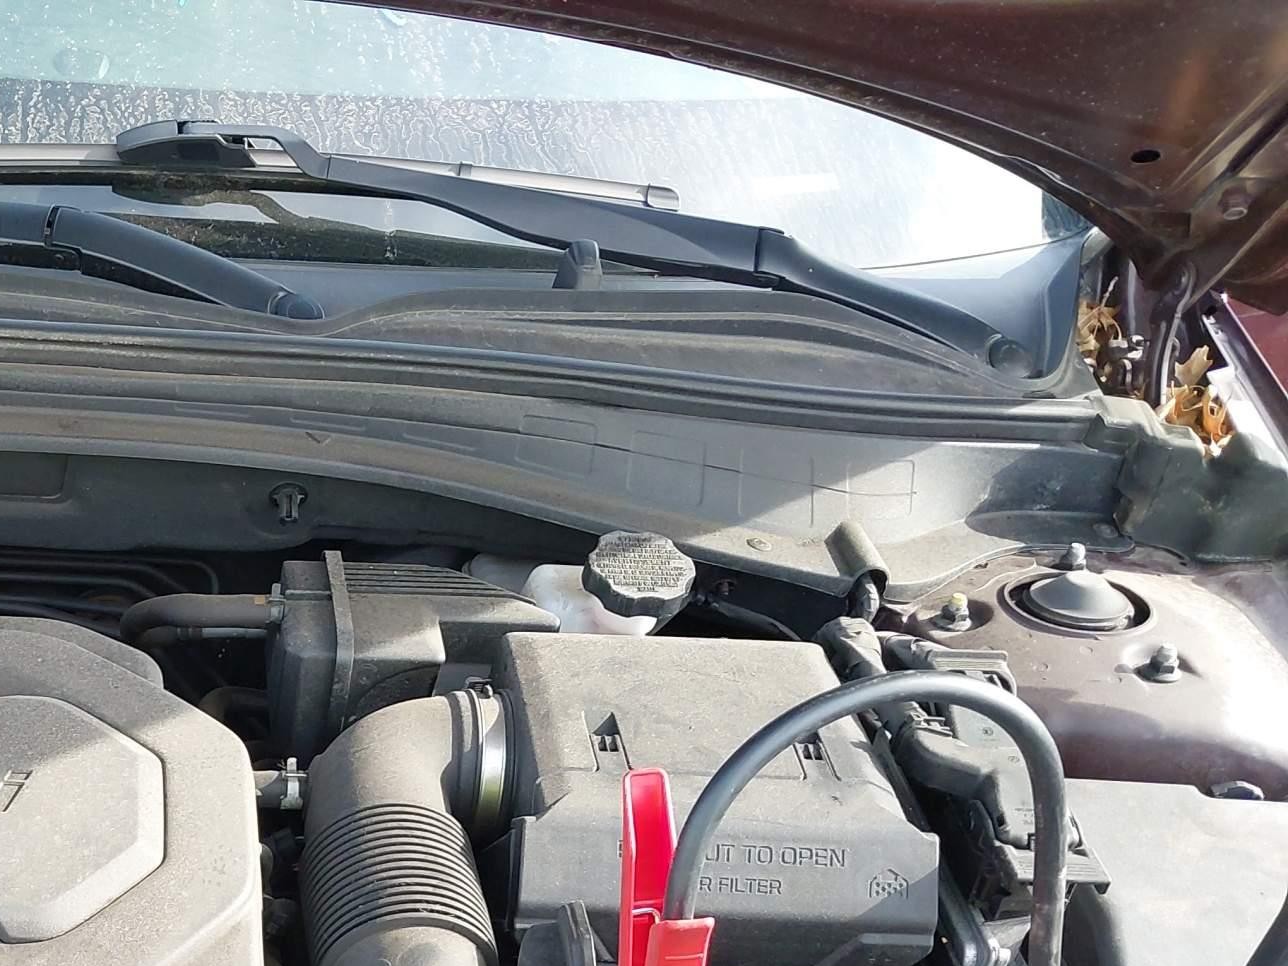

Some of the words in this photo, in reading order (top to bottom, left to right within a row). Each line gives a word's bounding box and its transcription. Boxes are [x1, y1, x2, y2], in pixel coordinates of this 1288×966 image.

[741, 844, 774, 865] TO
[780, 846, 847, 868] OPEN
[718, 877, 783, 896] FILTER
